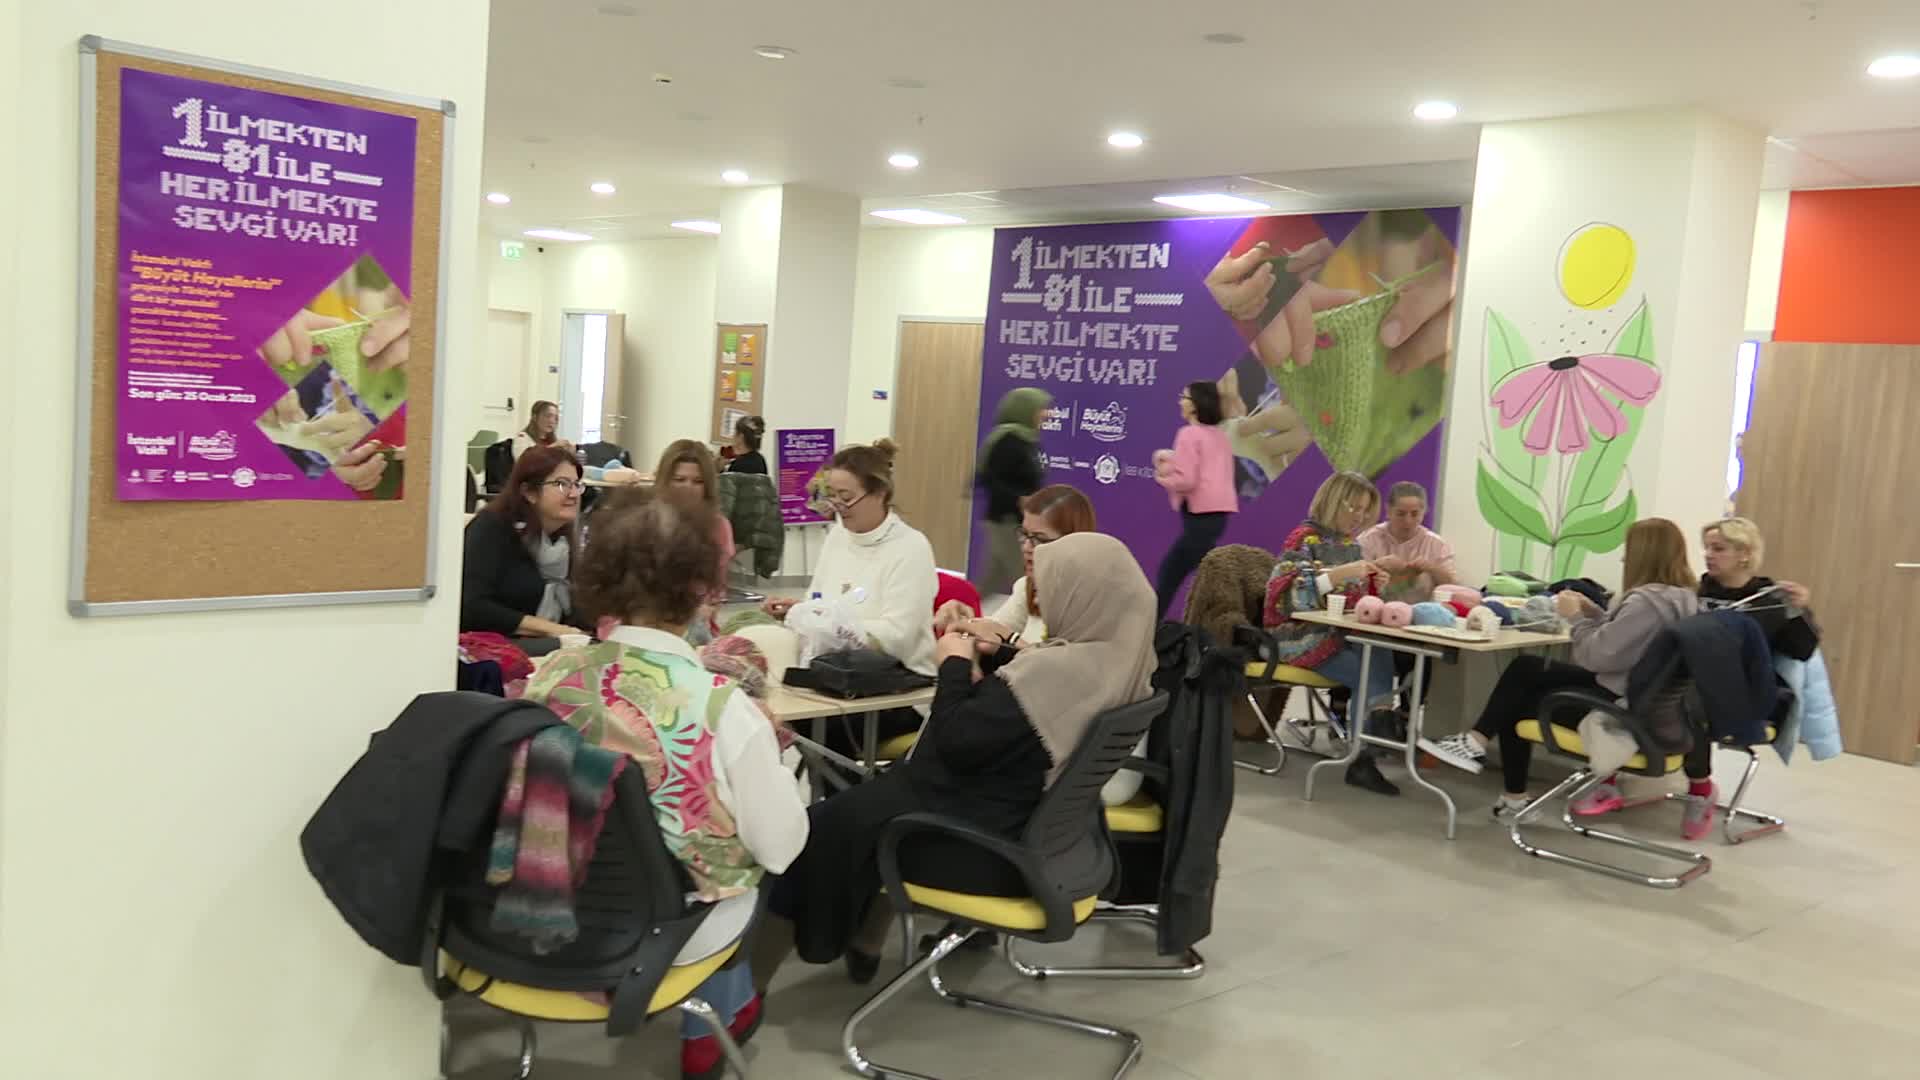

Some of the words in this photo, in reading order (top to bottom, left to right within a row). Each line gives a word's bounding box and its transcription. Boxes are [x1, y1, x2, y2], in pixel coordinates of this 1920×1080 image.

[171, 98, 208, 148] 1
[206, 105, 368, 155] İLMEKTEN
[222, 138, 273, 178] 81
[275, 152, 332, 185] İLE
[160, 171, 229, 202] HER
[233, 176, 379, 222] İLMEKTE
[172, 205, 278, 239] SEVGİ
[282, 221, 359, 247] VAR!
[1011, 236, 1035, 289] 1
[1033, 240, 1171, 270] İLMEKTEN
[1043, 273, 1082, 313] 81
[1083, 279, 1133, 314] İLE
[1000, 319, 1049, 345] HER
[1051, 314, 1180, 352] İLMEKTE
[1005, 351, 1084, 383] SEVGİ
[1087, 358, 1158, 386] VAR!
[1041, 418, 1062, 431] akfı
[1047, 406, 1070, 419] nbul
